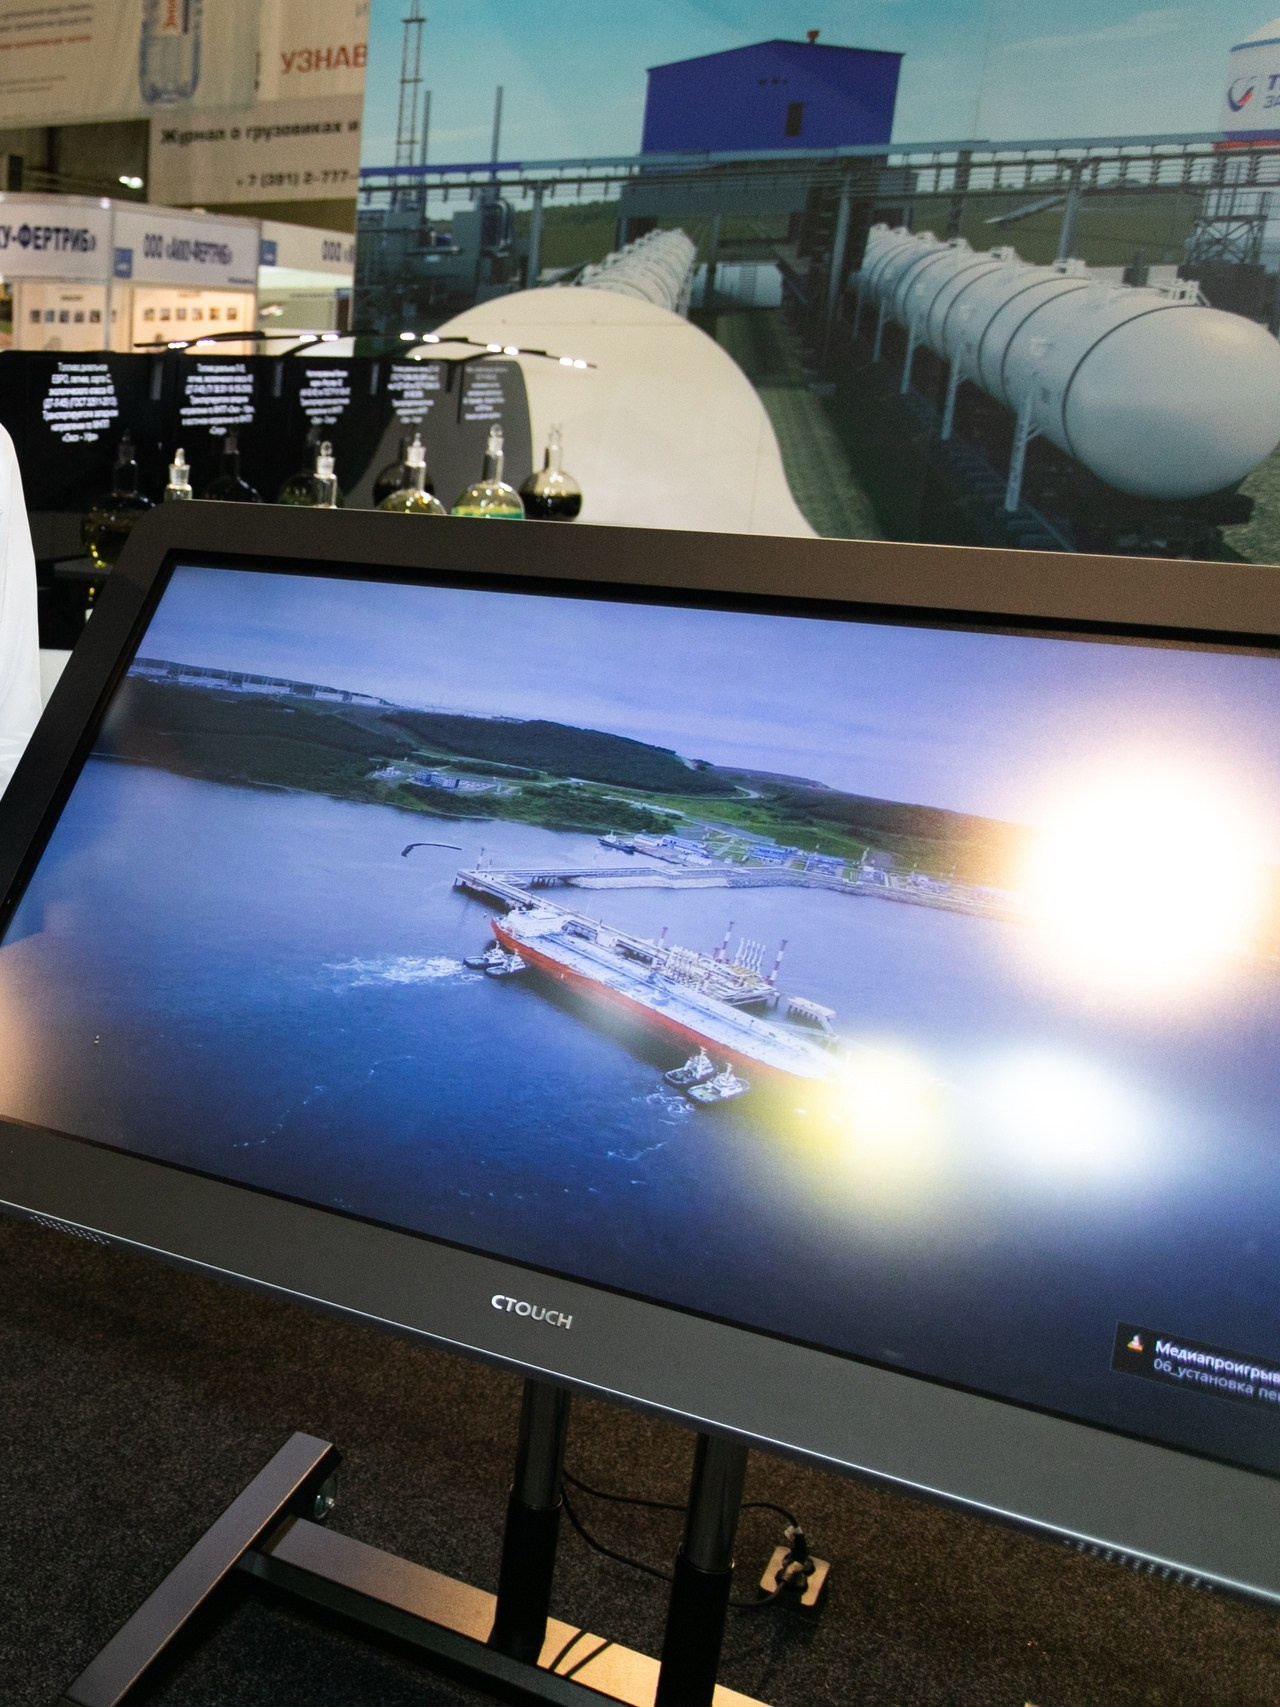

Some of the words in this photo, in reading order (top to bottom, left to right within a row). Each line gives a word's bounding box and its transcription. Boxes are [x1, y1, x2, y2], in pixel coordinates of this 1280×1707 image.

[160, 127, 226, 146] Журнал
[230, 127, 242, 141] о
[245, 121, 342, 145] грузовиках
[143, 232, 164, 259] ООО
[491, 1294, 573, 1330] CTOUCH
[1155, 1340, 1280, 1383] Медиапроигрыв
